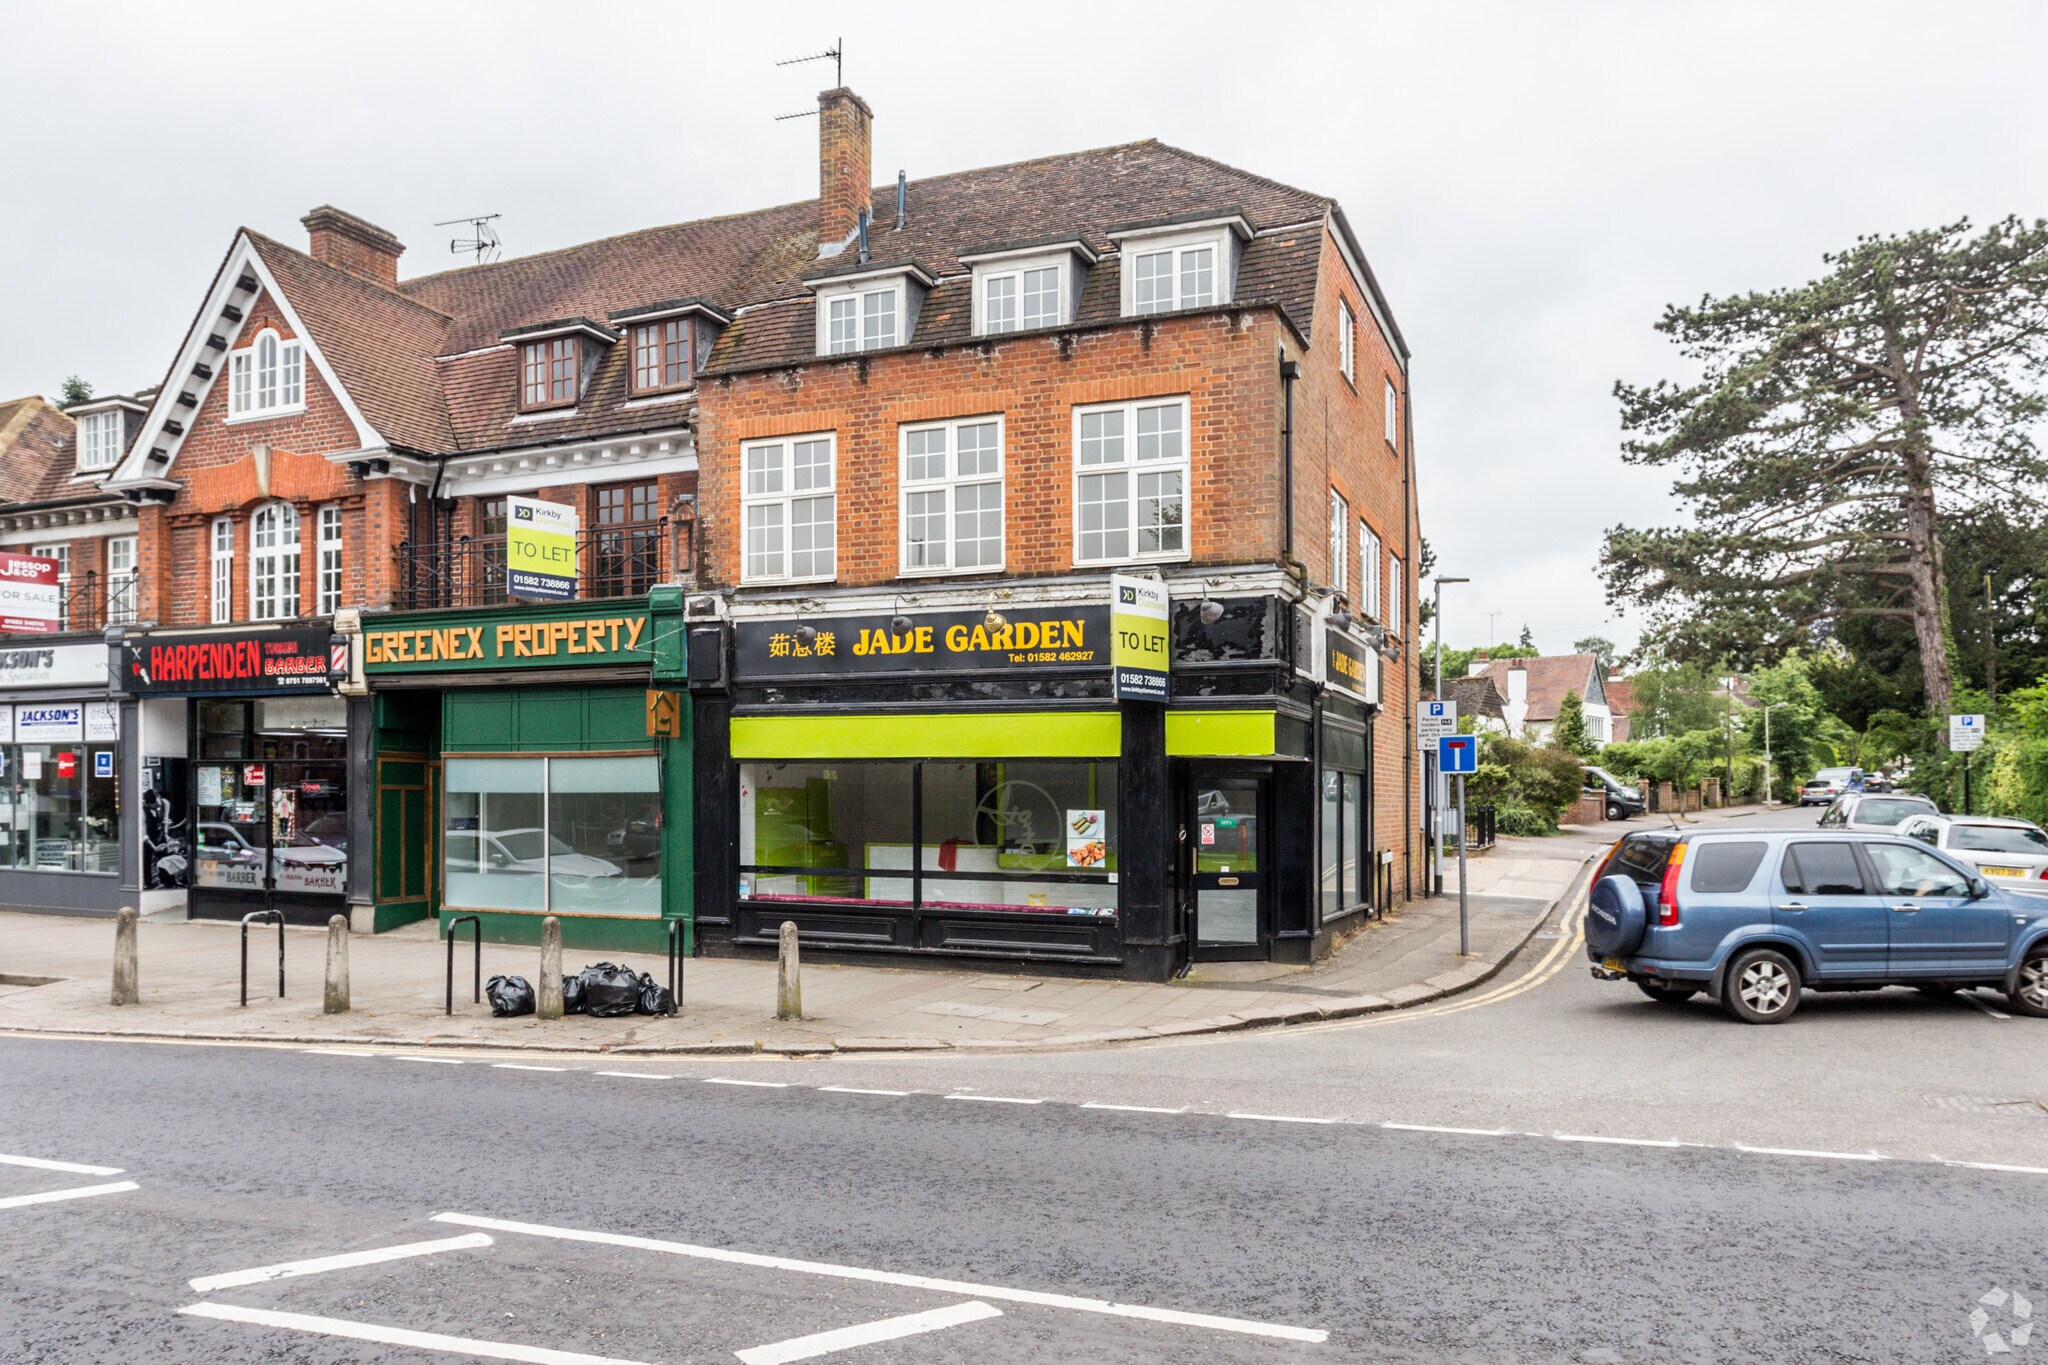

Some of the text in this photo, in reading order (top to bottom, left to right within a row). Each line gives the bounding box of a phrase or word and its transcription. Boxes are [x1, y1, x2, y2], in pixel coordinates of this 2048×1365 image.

[536, 508, 561, 520] Kirkby
[536, 516, 571, 528] Diamond
[514, 540, 572, 562] TO LET
[0, 560, 51, 576] Jessop
[13, 568, 38, 578] &co
[514, 574, 570, 590] 01582 738866
[24, 592, 56, 603] SALE
[1138, 588, 1159, 601] Kirkby
[1139, 598, 1166, 611] Diamond
[366, 616, 646, 664] GREENEX PROPERTY
[852, 620, 1086, 656] JADE GARDEN
[1119, 631, 1165, 654] TO LET
[151, 640, 260, 682] HARPENDEN
[1008, 650, 1094, 662] Tel: 01582 462927
[264, 655, 326, 676] BARBER
[1120, 672, 1144, 686] 01582
[21, 708, 78, 722] JACKSON'S
[226, 872, 256, 885] BARBER
[1590, 903, 1616, 926] HONDA
